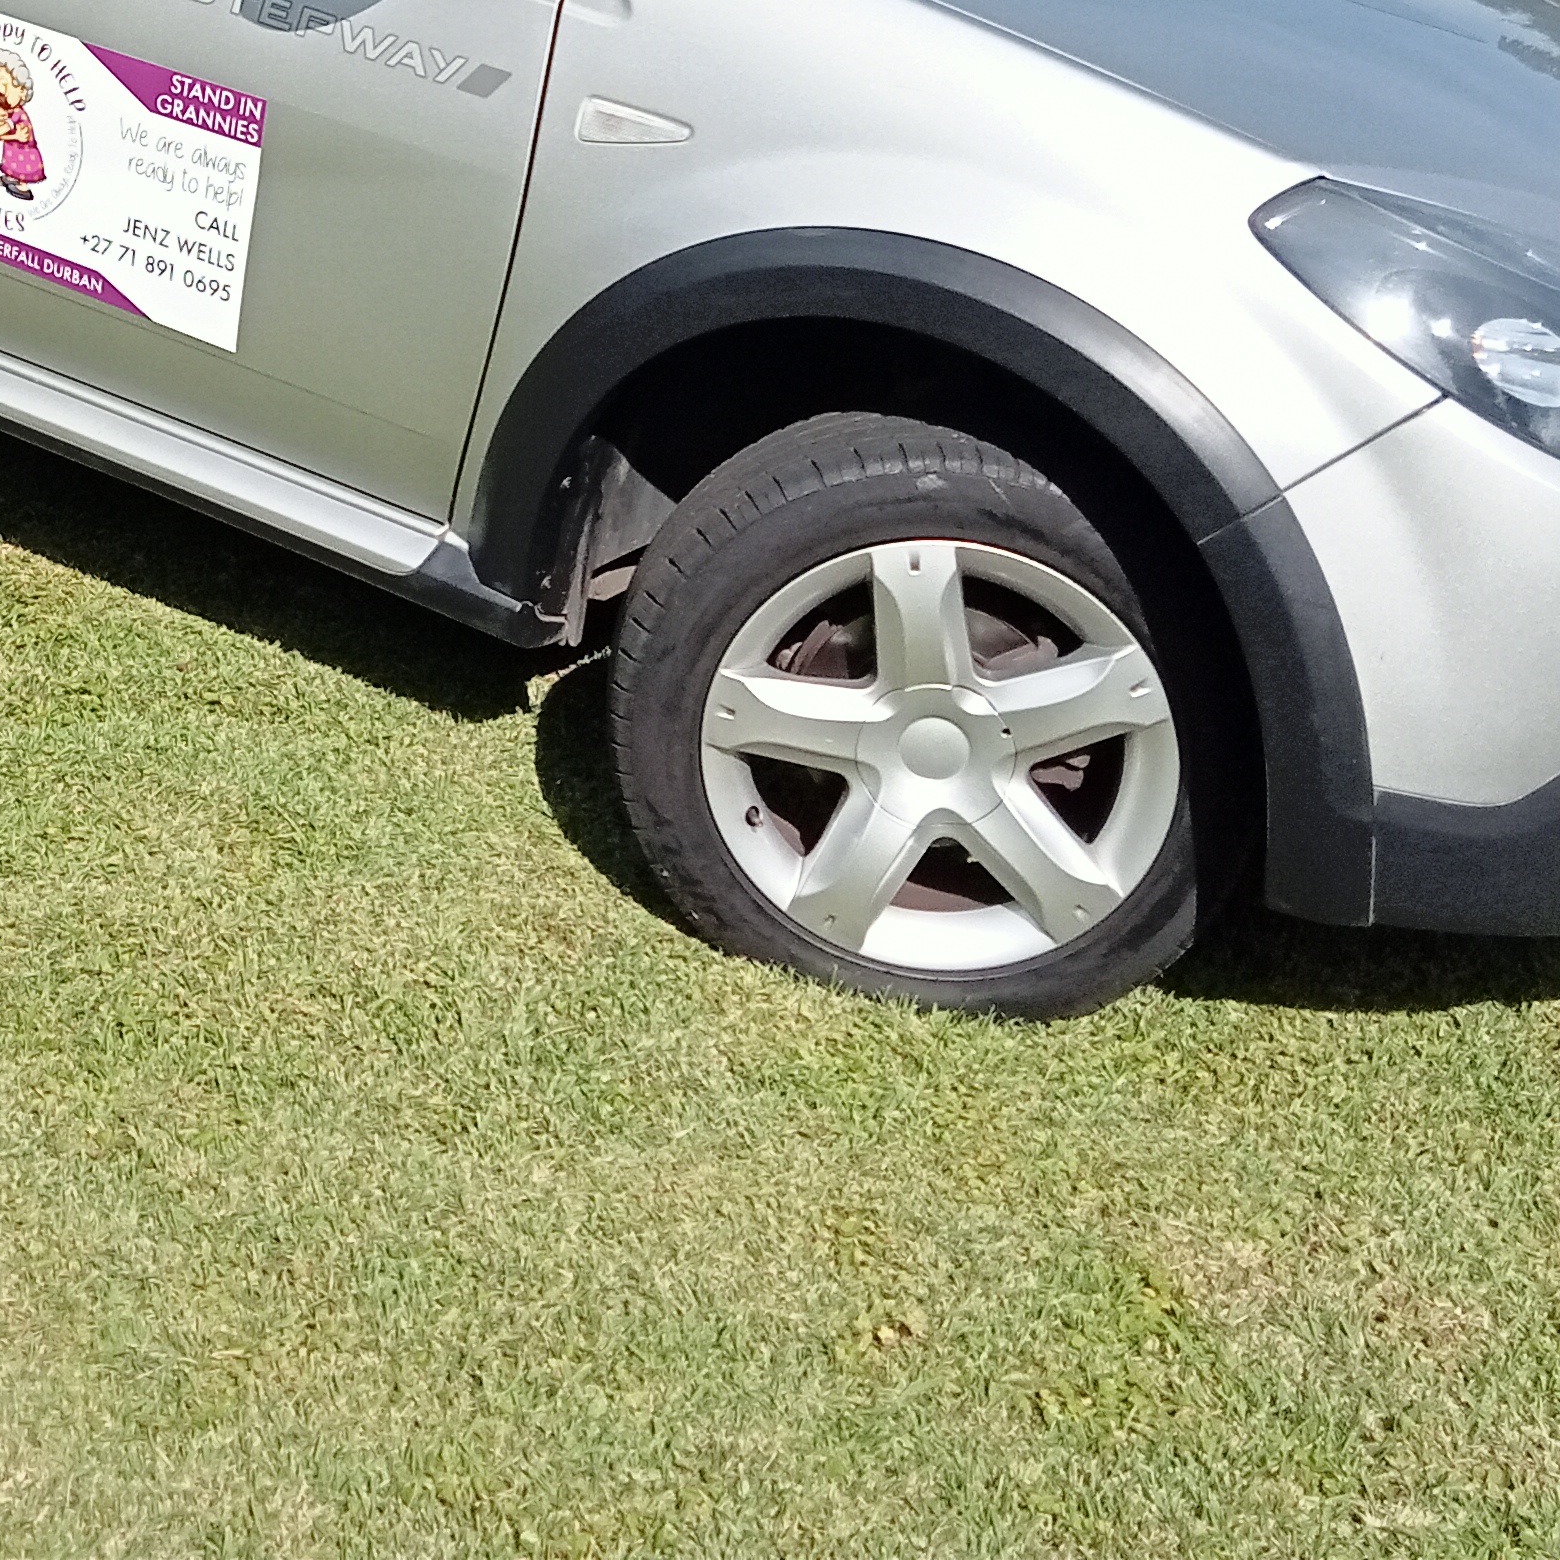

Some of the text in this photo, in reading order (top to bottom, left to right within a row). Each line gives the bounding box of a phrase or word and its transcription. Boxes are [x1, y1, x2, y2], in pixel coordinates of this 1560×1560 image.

[30, 34, 53, 62] TO
[50, 59, 87, 112] HELP
[155, 95, 260, 143] GRANNIES
[171, 74, 263, 121] STAND IN
[119, 117, 248, 184] We are always
[127, 156, 175, 192] ready
[182, 168, 200, 194] to
[122, 217, 236, 272] JENZ WELLS
[195, 210, 239, 242] CALL
[43, 256, 104, 294] DURBAN
[79, 232, 232, 302] +27 71 891 0695
